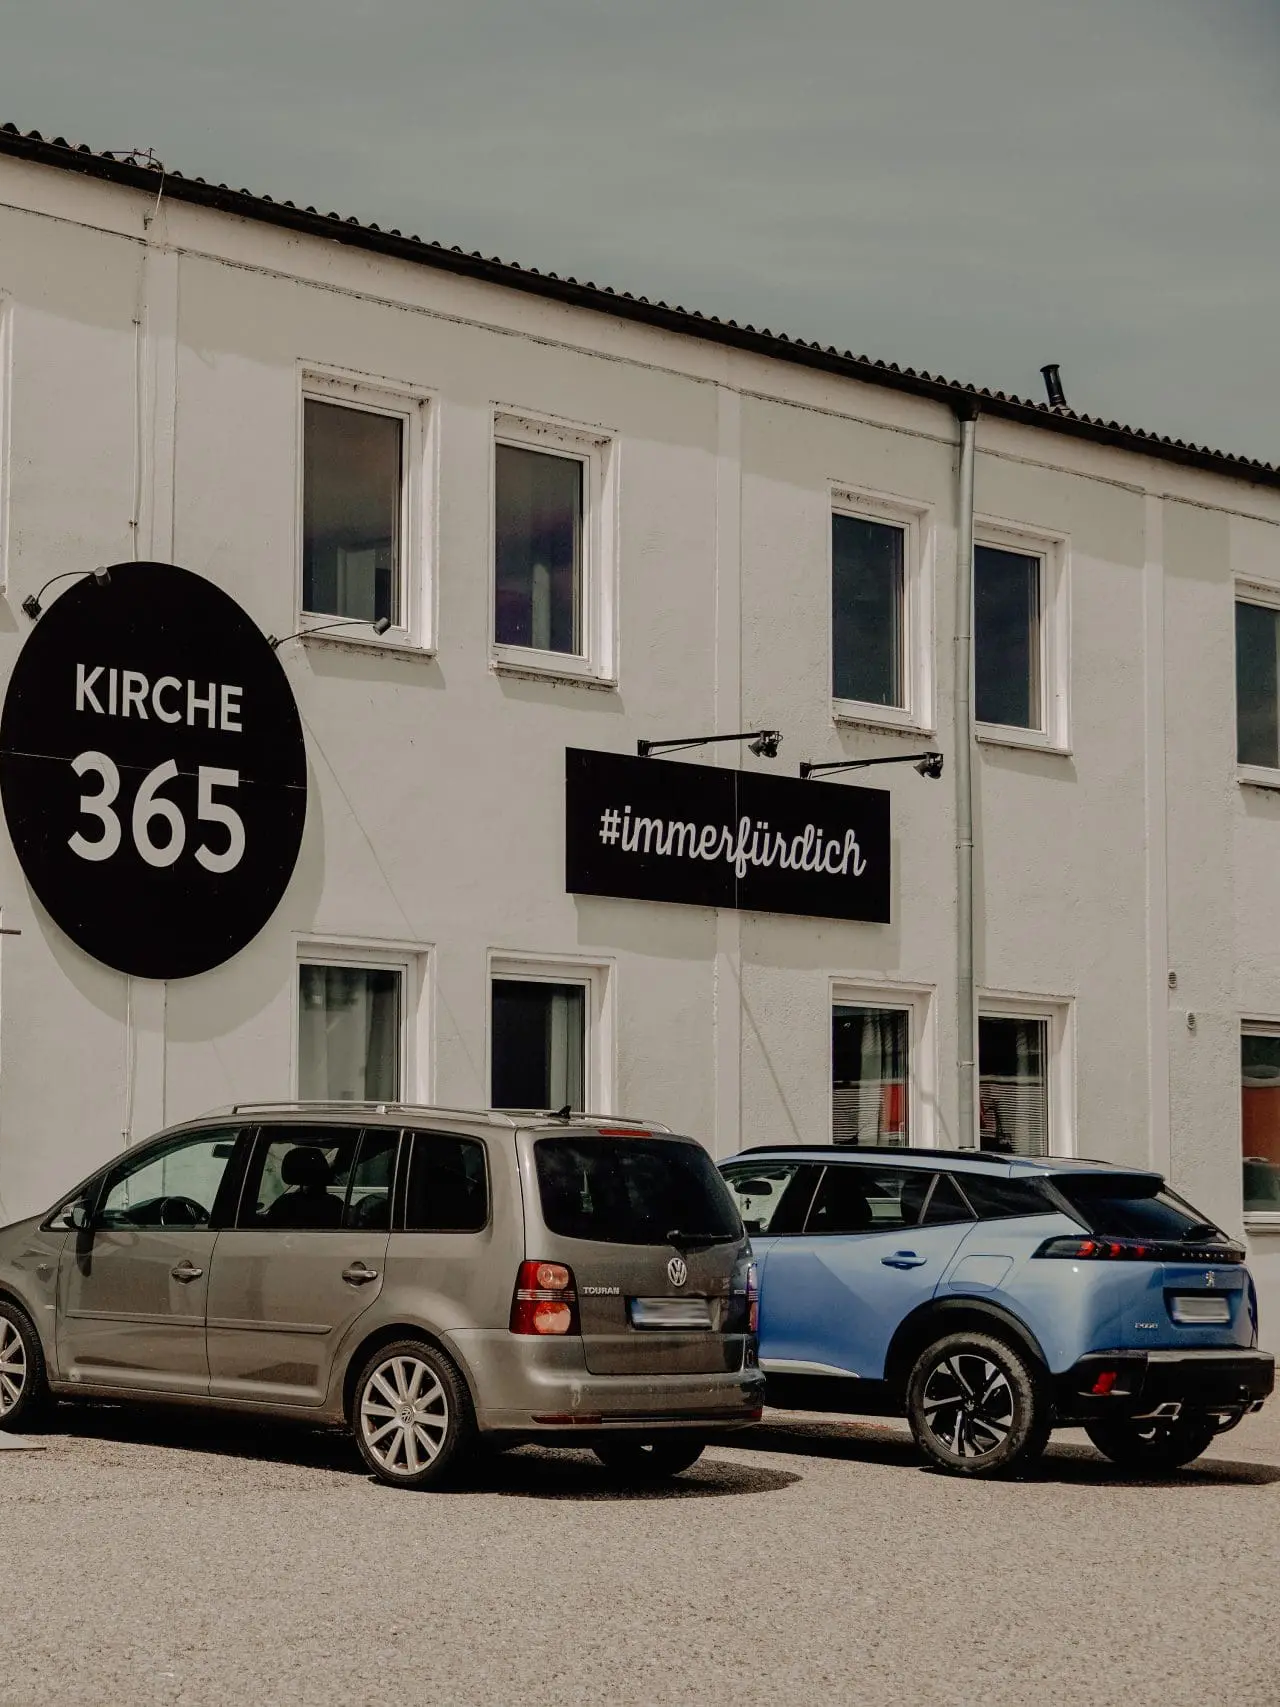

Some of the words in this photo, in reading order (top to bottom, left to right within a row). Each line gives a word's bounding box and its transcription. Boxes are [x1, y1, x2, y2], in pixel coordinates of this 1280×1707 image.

[75, 663, 243, 732] KIRCHE
[67, 750, 246, 873] 365
[599, 805, 867, 878] #immerfürdich
[582, 1286, 620, 1295] TOURAN
